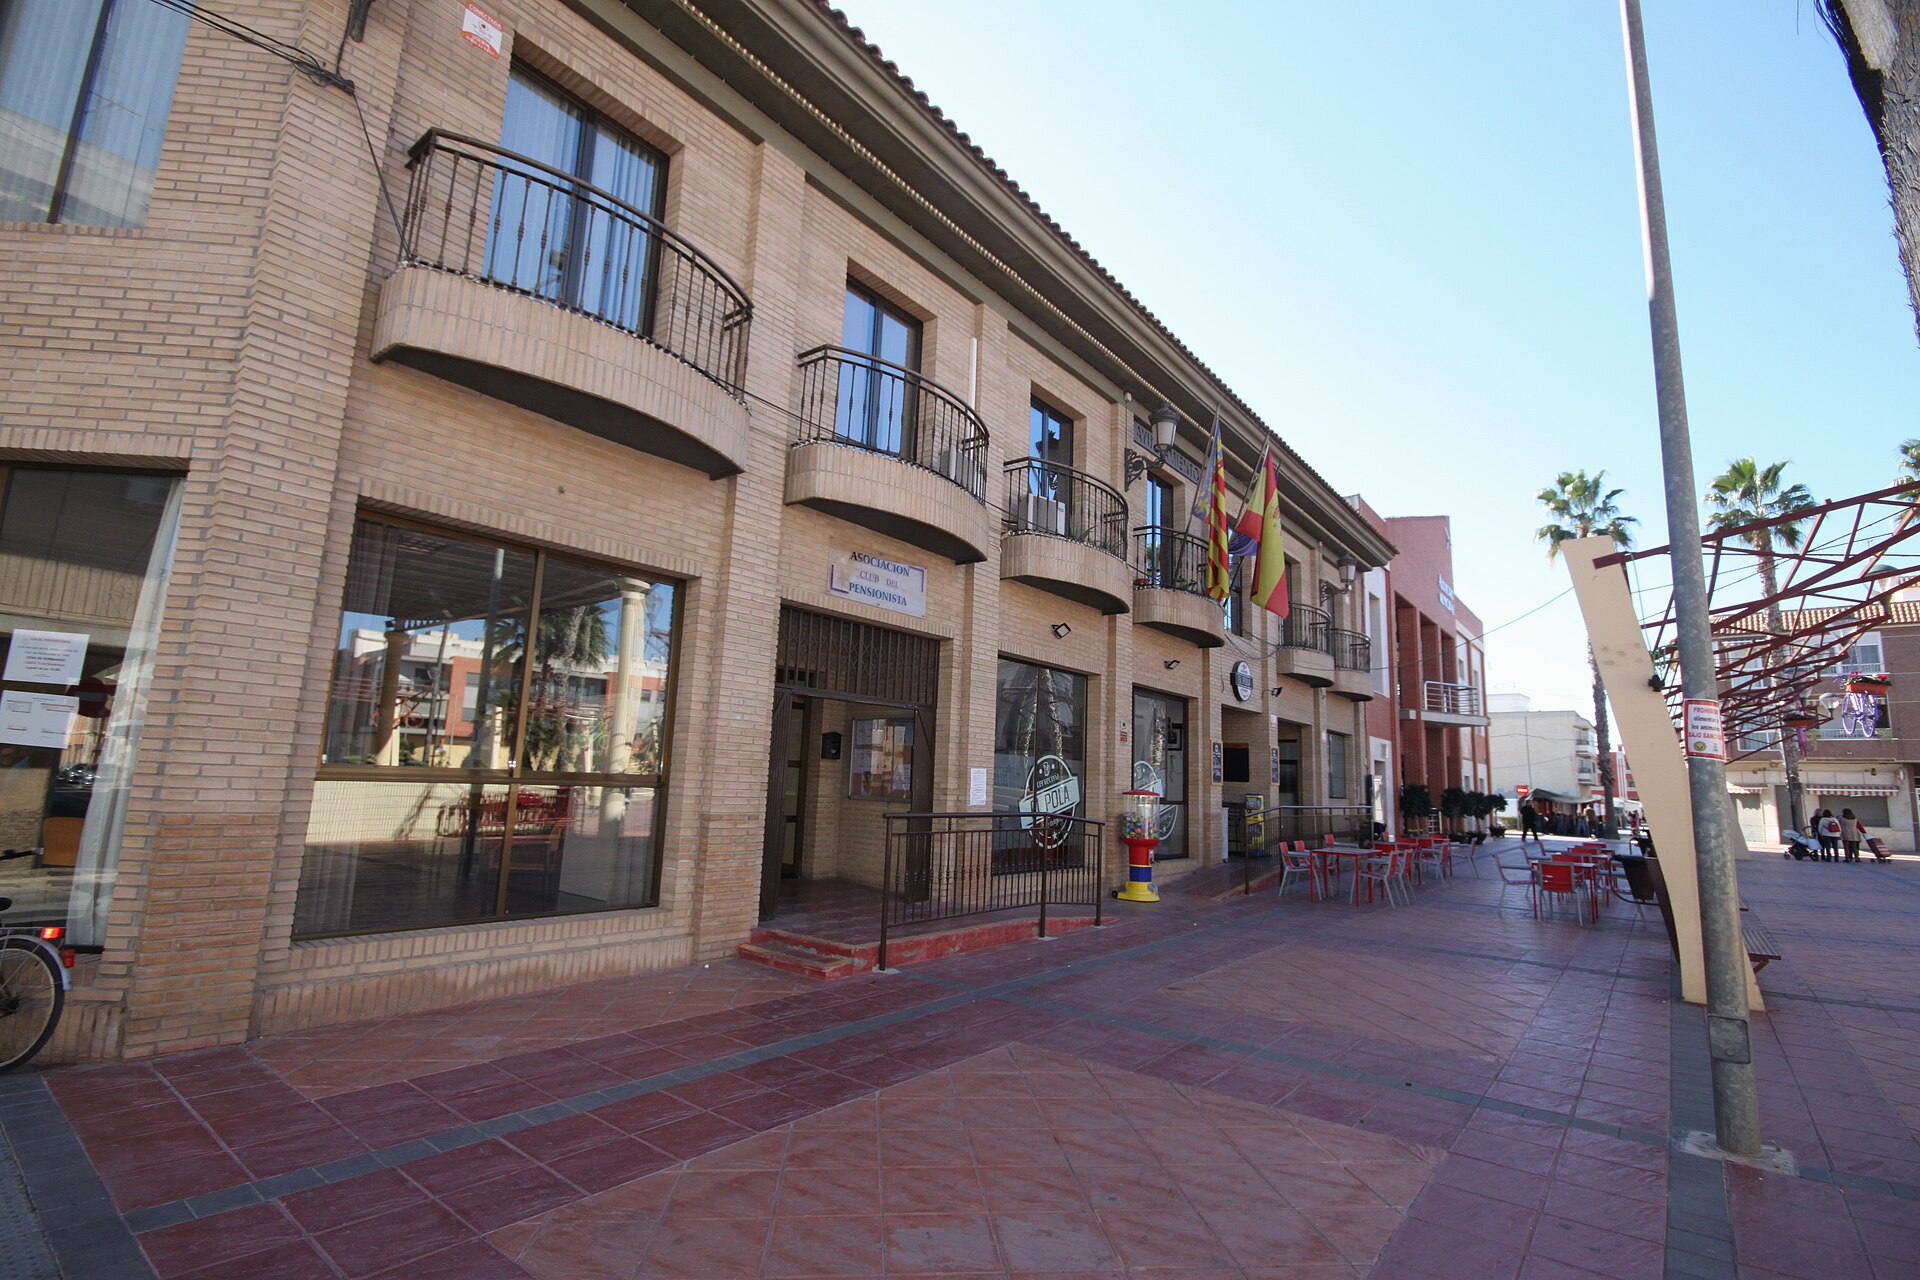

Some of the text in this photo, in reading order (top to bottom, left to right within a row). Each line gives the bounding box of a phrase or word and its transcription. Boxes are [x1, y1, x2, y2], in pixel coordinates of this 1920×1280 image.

[1135, 425, 1200, 482] AYUMIENTO
[850, 551, 910, 577] ASOCIACION
[860, 570, 899, 589] CLUB DEL
[848, 581, 908, 606] PENSIONISTA
[1044, 785, 1070, 812] POLA
